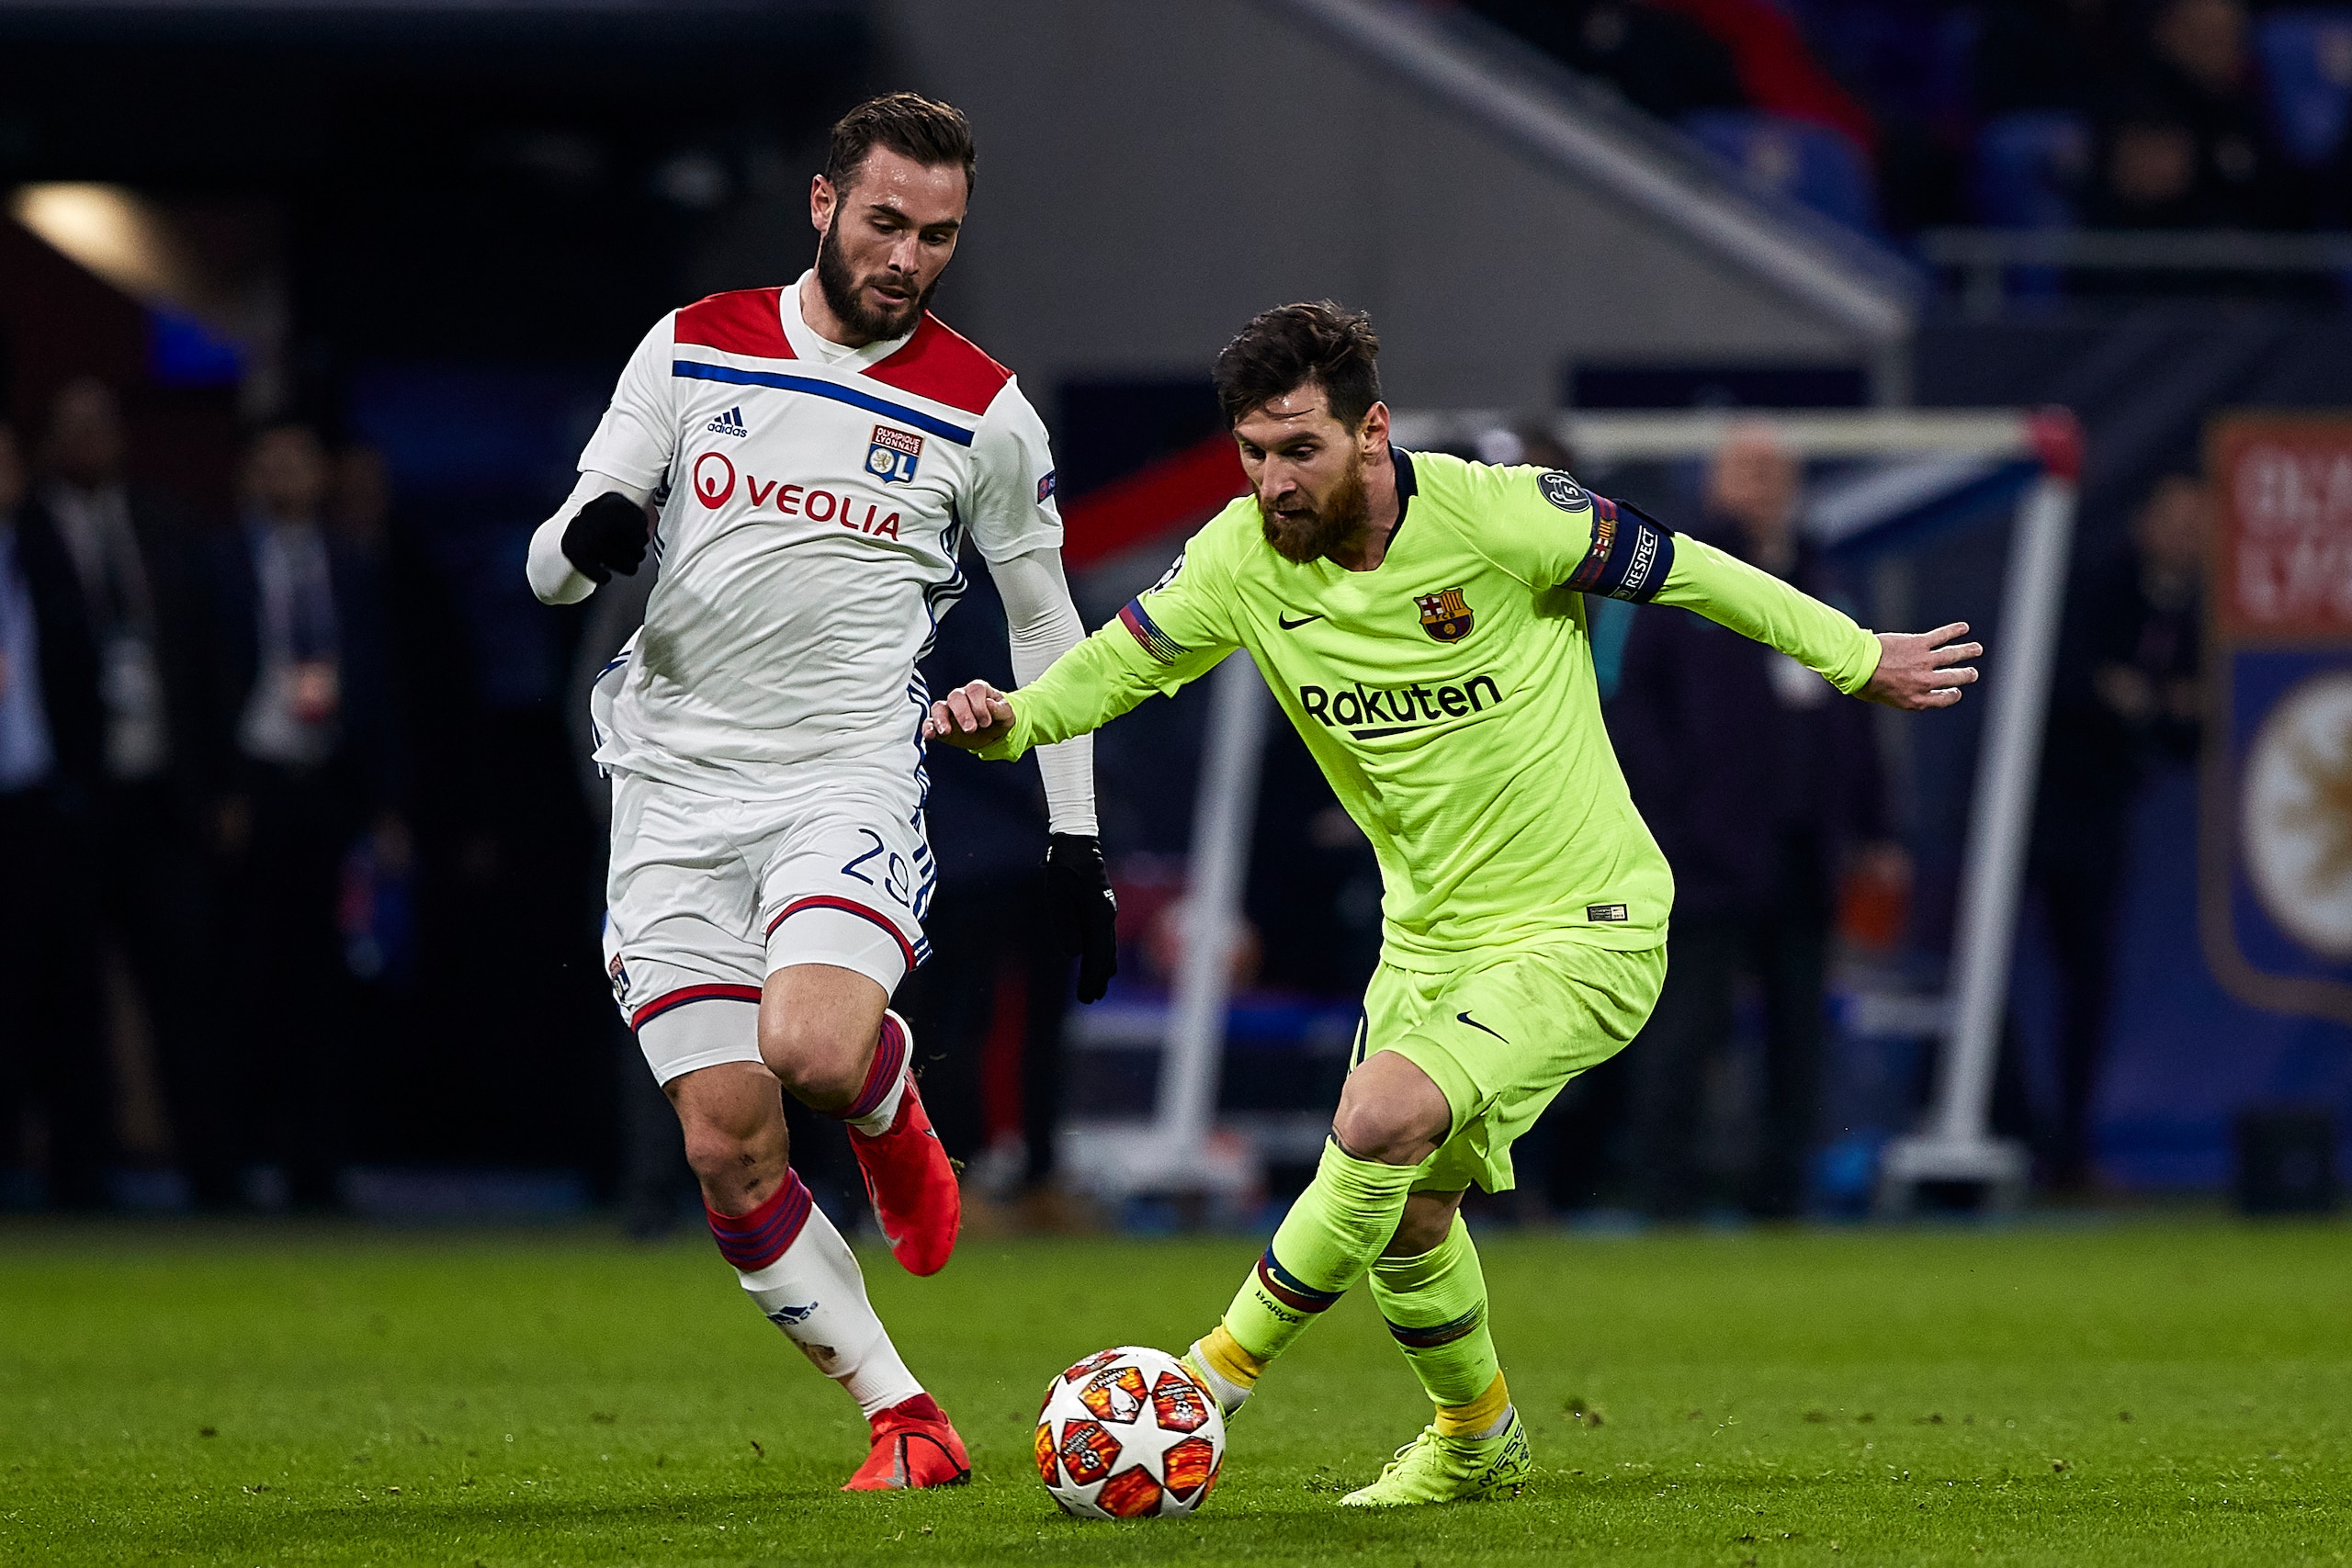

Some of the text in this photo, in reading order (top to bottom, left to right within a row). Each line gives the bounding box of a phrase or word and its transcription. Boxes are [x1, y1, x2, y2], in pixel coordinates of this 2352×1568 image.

[707, 422, 748, 438] adidas
[875, 434, 919, 454] LYONNAIS
[876, 427, 921, 447] OLYMPIQUE
[747, 475, 899, 542] VEOLIA
[1624, 527, 1655, 589] RESPECT
[1299, 675, 1503, 728] Rakuten
[841, 829, 910, 908] 29
